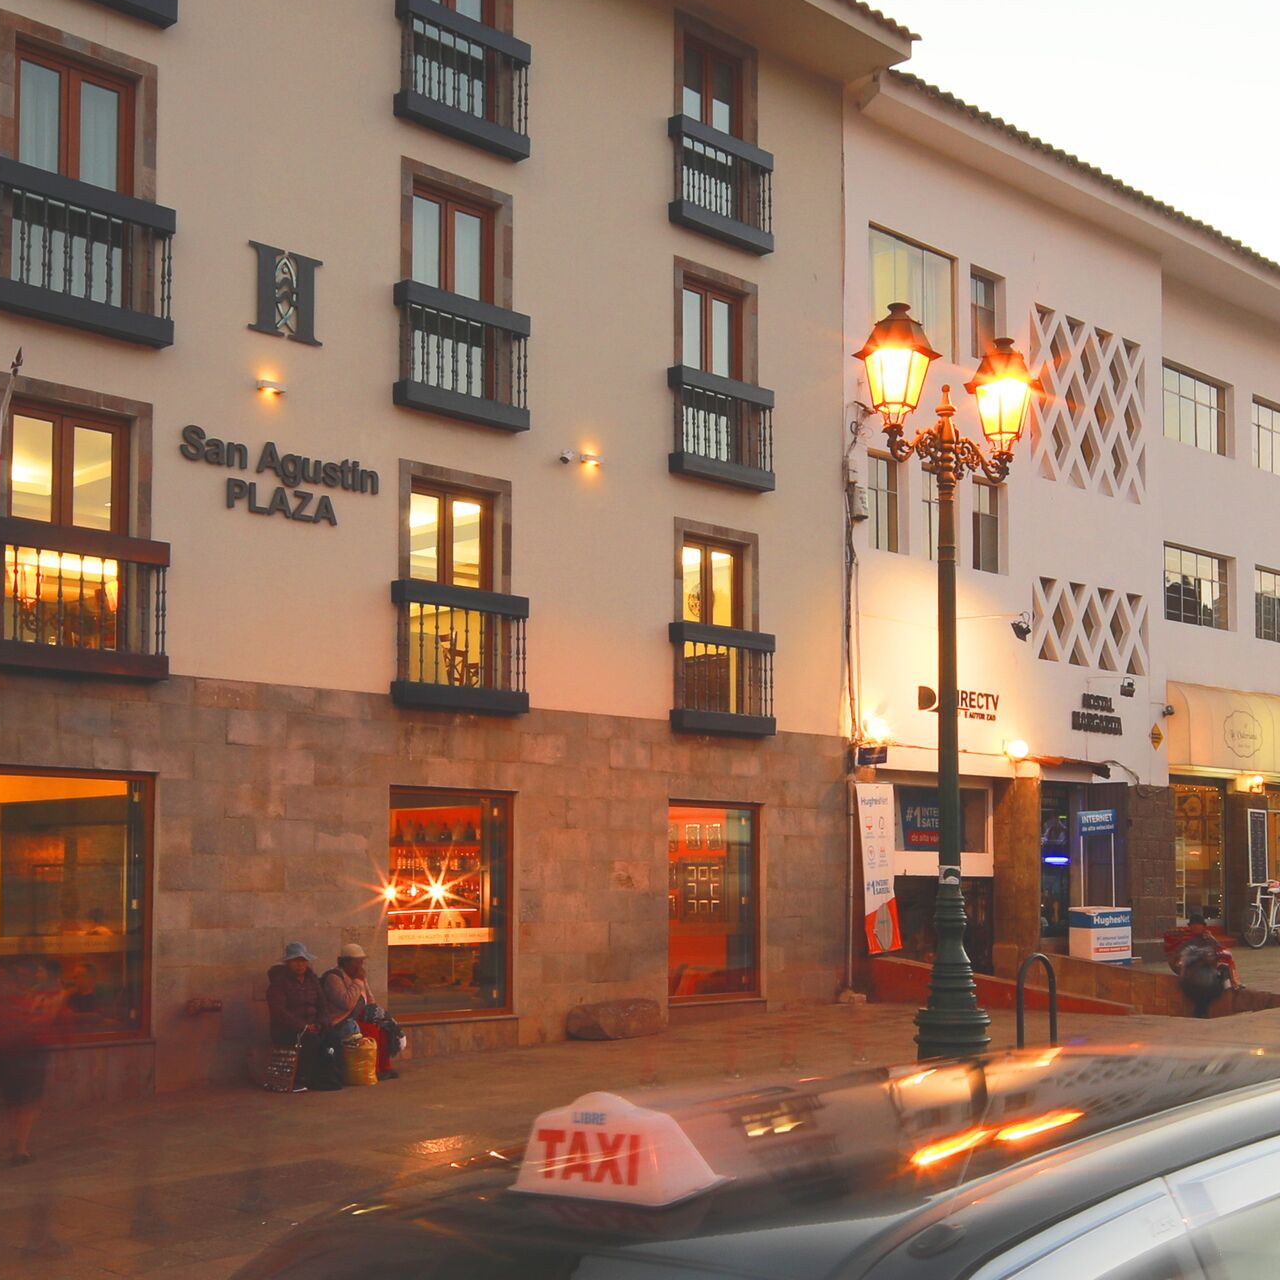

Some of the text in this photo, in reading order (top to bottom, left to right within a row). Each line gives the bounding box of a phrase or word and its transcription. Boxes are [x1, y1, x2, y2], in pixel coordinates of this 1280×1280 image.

[180, 424, 379, 495] San Agustin
[226, 477, 337, 526] PLAZA
[1081, 813, 1113, 823] INTERNET
[573, 1111, 607, 1125] LIBRE
[538, 1129, 641, 1186] TAXI
